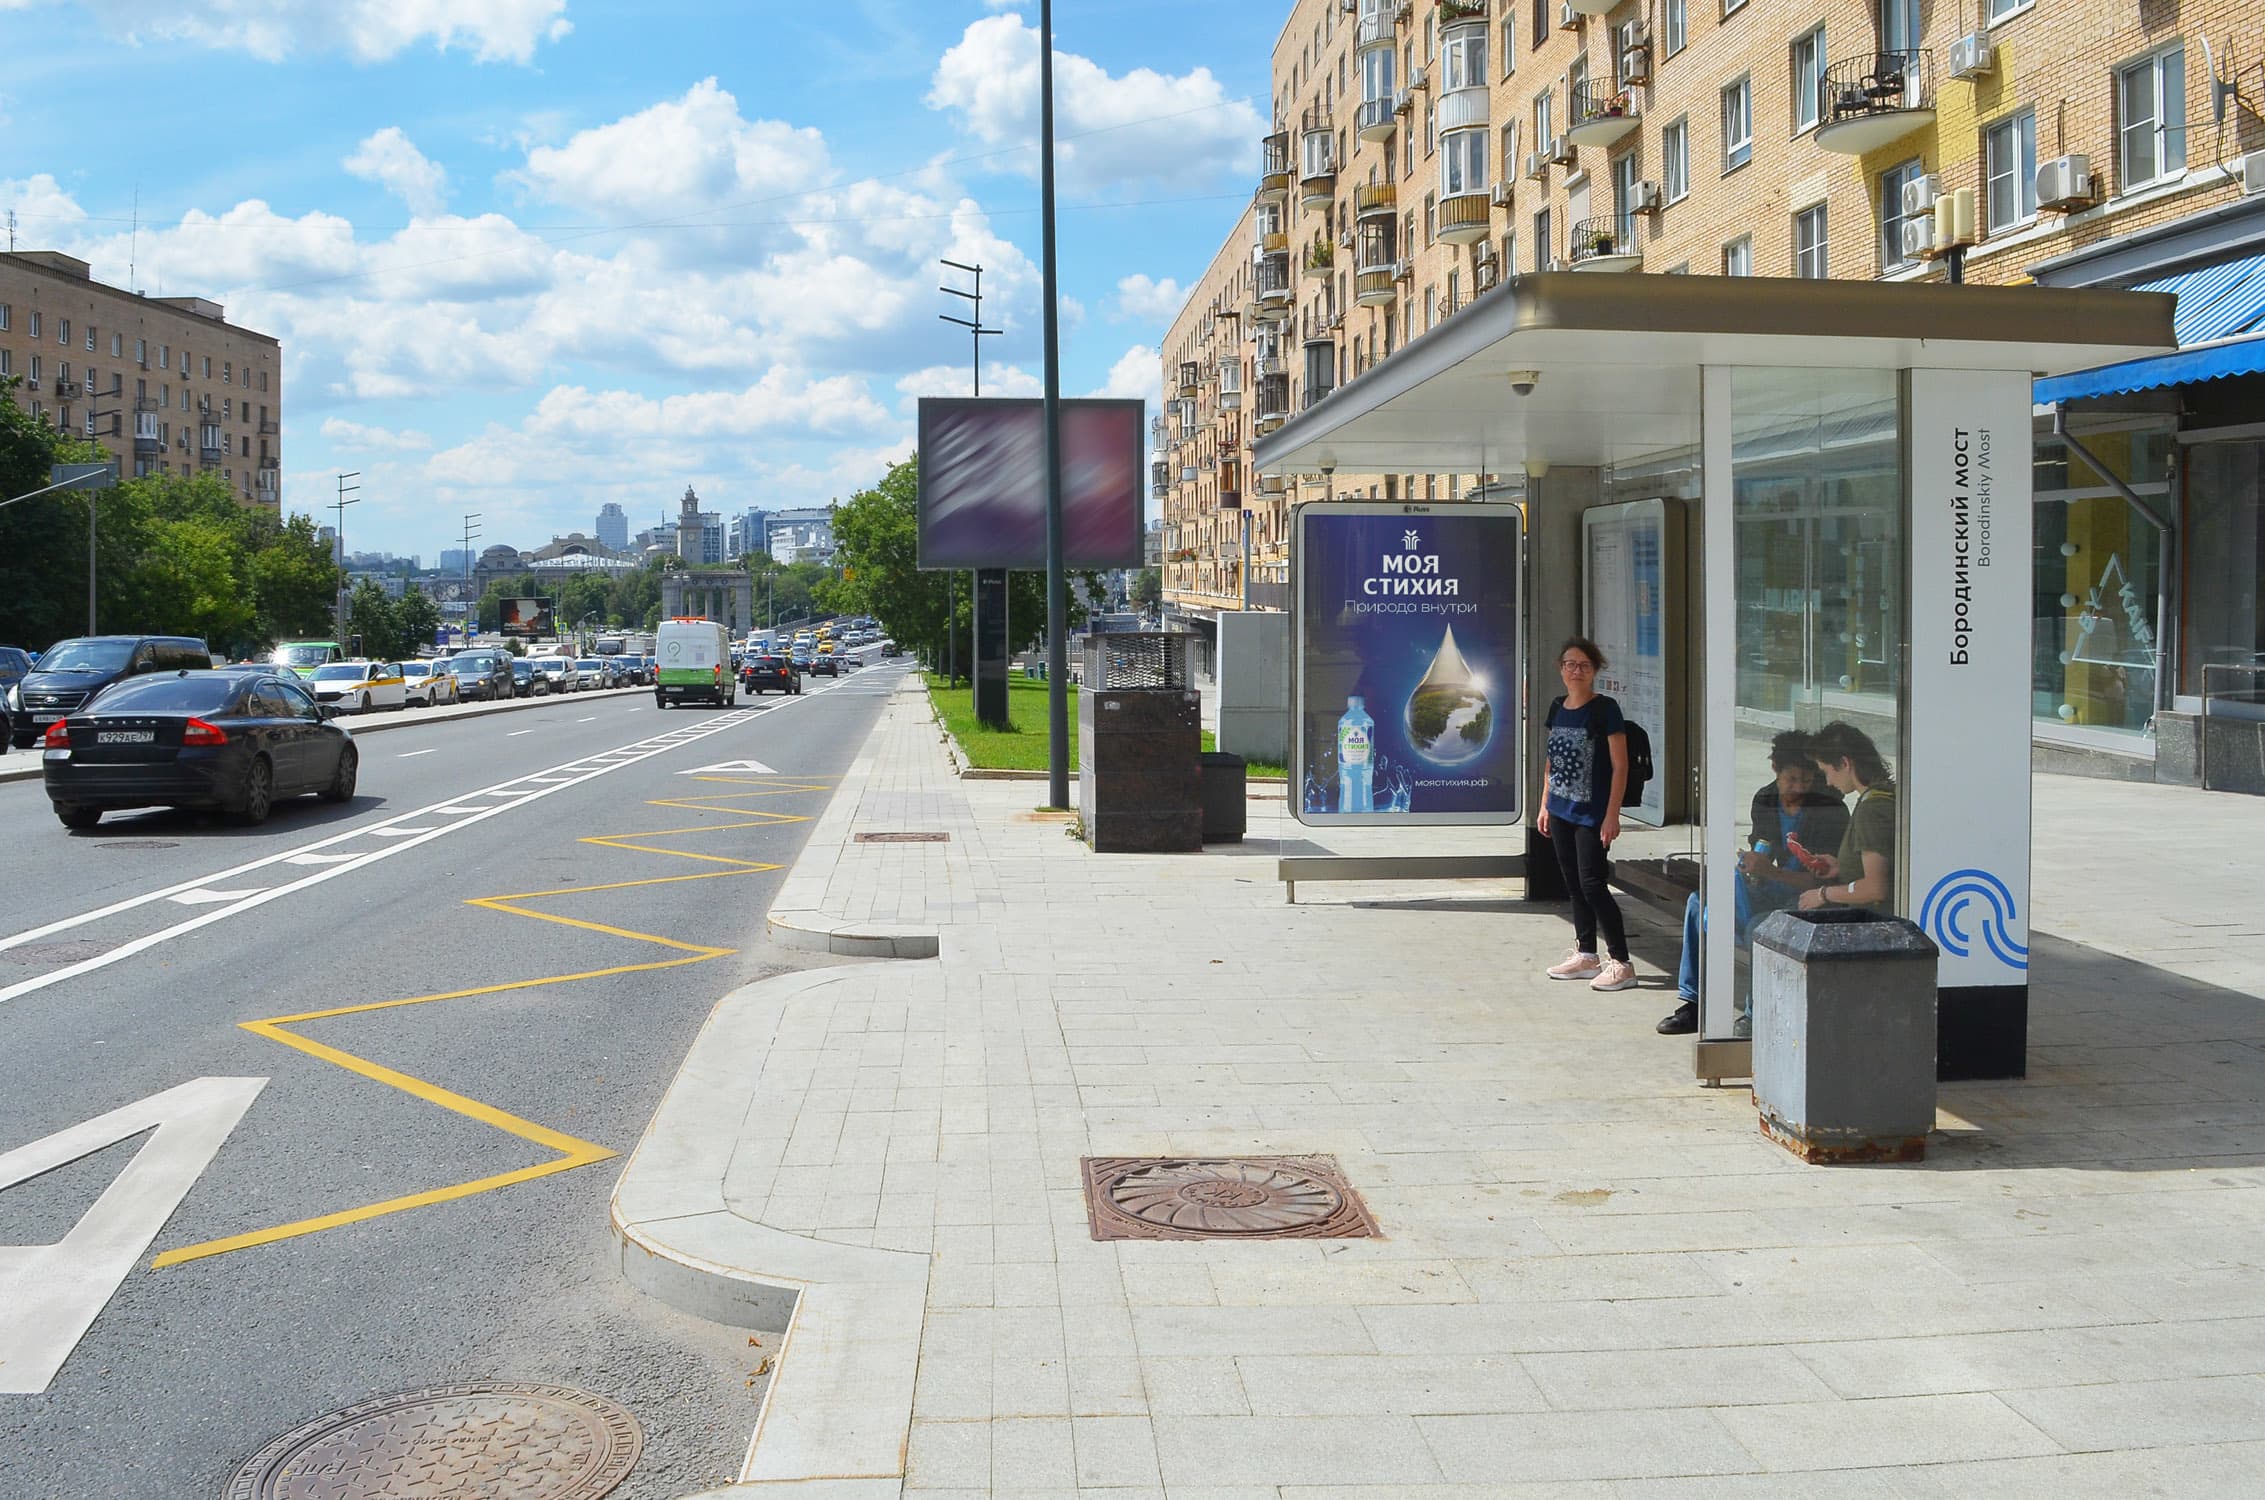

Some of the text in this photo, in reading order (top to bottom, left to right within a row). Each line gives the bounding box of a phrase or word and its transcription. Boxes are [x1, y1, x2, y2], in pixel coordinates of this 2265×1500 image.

[1977, 428, 1993, 567] Borodinskiy Most
[1950, 427, 1973, 665] Бородинский мост
[1382, 554, 1440, 574] МОЯ
[1362, 577, 1459, 596] СТИХИЯ
[1344, 599, 1477, 615] Природа внутри
[1414, 778, 1489, 788] моястихия.рф
